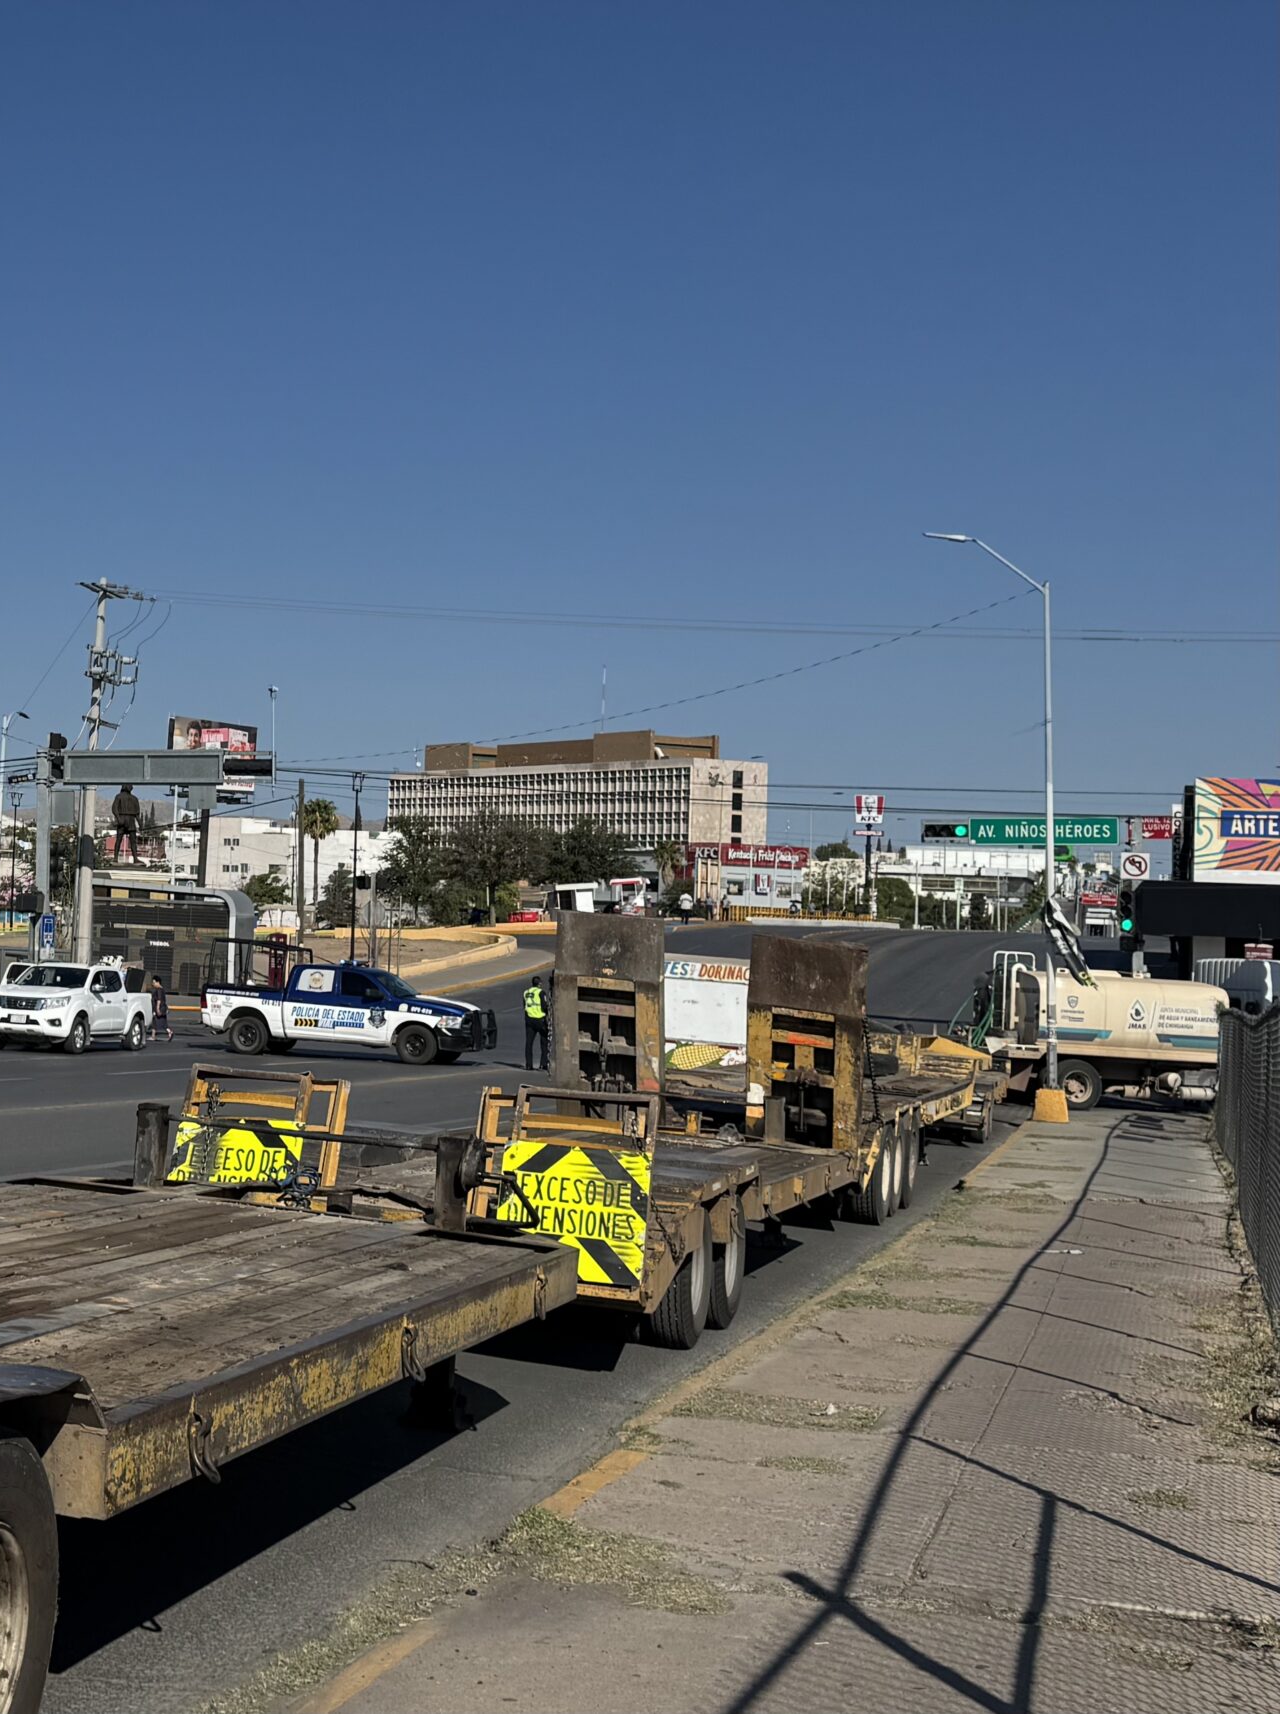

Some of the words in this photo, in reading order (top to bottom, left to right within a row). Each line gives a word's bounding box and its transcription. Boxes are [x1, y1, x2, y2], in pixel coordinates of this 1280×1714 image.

[860, 814, 879, 822] KFC
[978, 824, 996, 838] AV.
[1005, 821, 1047, 838] NIÑOS
[1055, 821, 1111, 838] HÉROES
[695, 847, 718, 858] KFC
[322, 1008, 335, 1019] DEL
[336, 1010, 365, 1022] ESTADO
[188, 1143, 255, 1172] ECESO
[520, 1173, 597, 1205] EXCESO
[602, 1182, 629, 1208] DE
